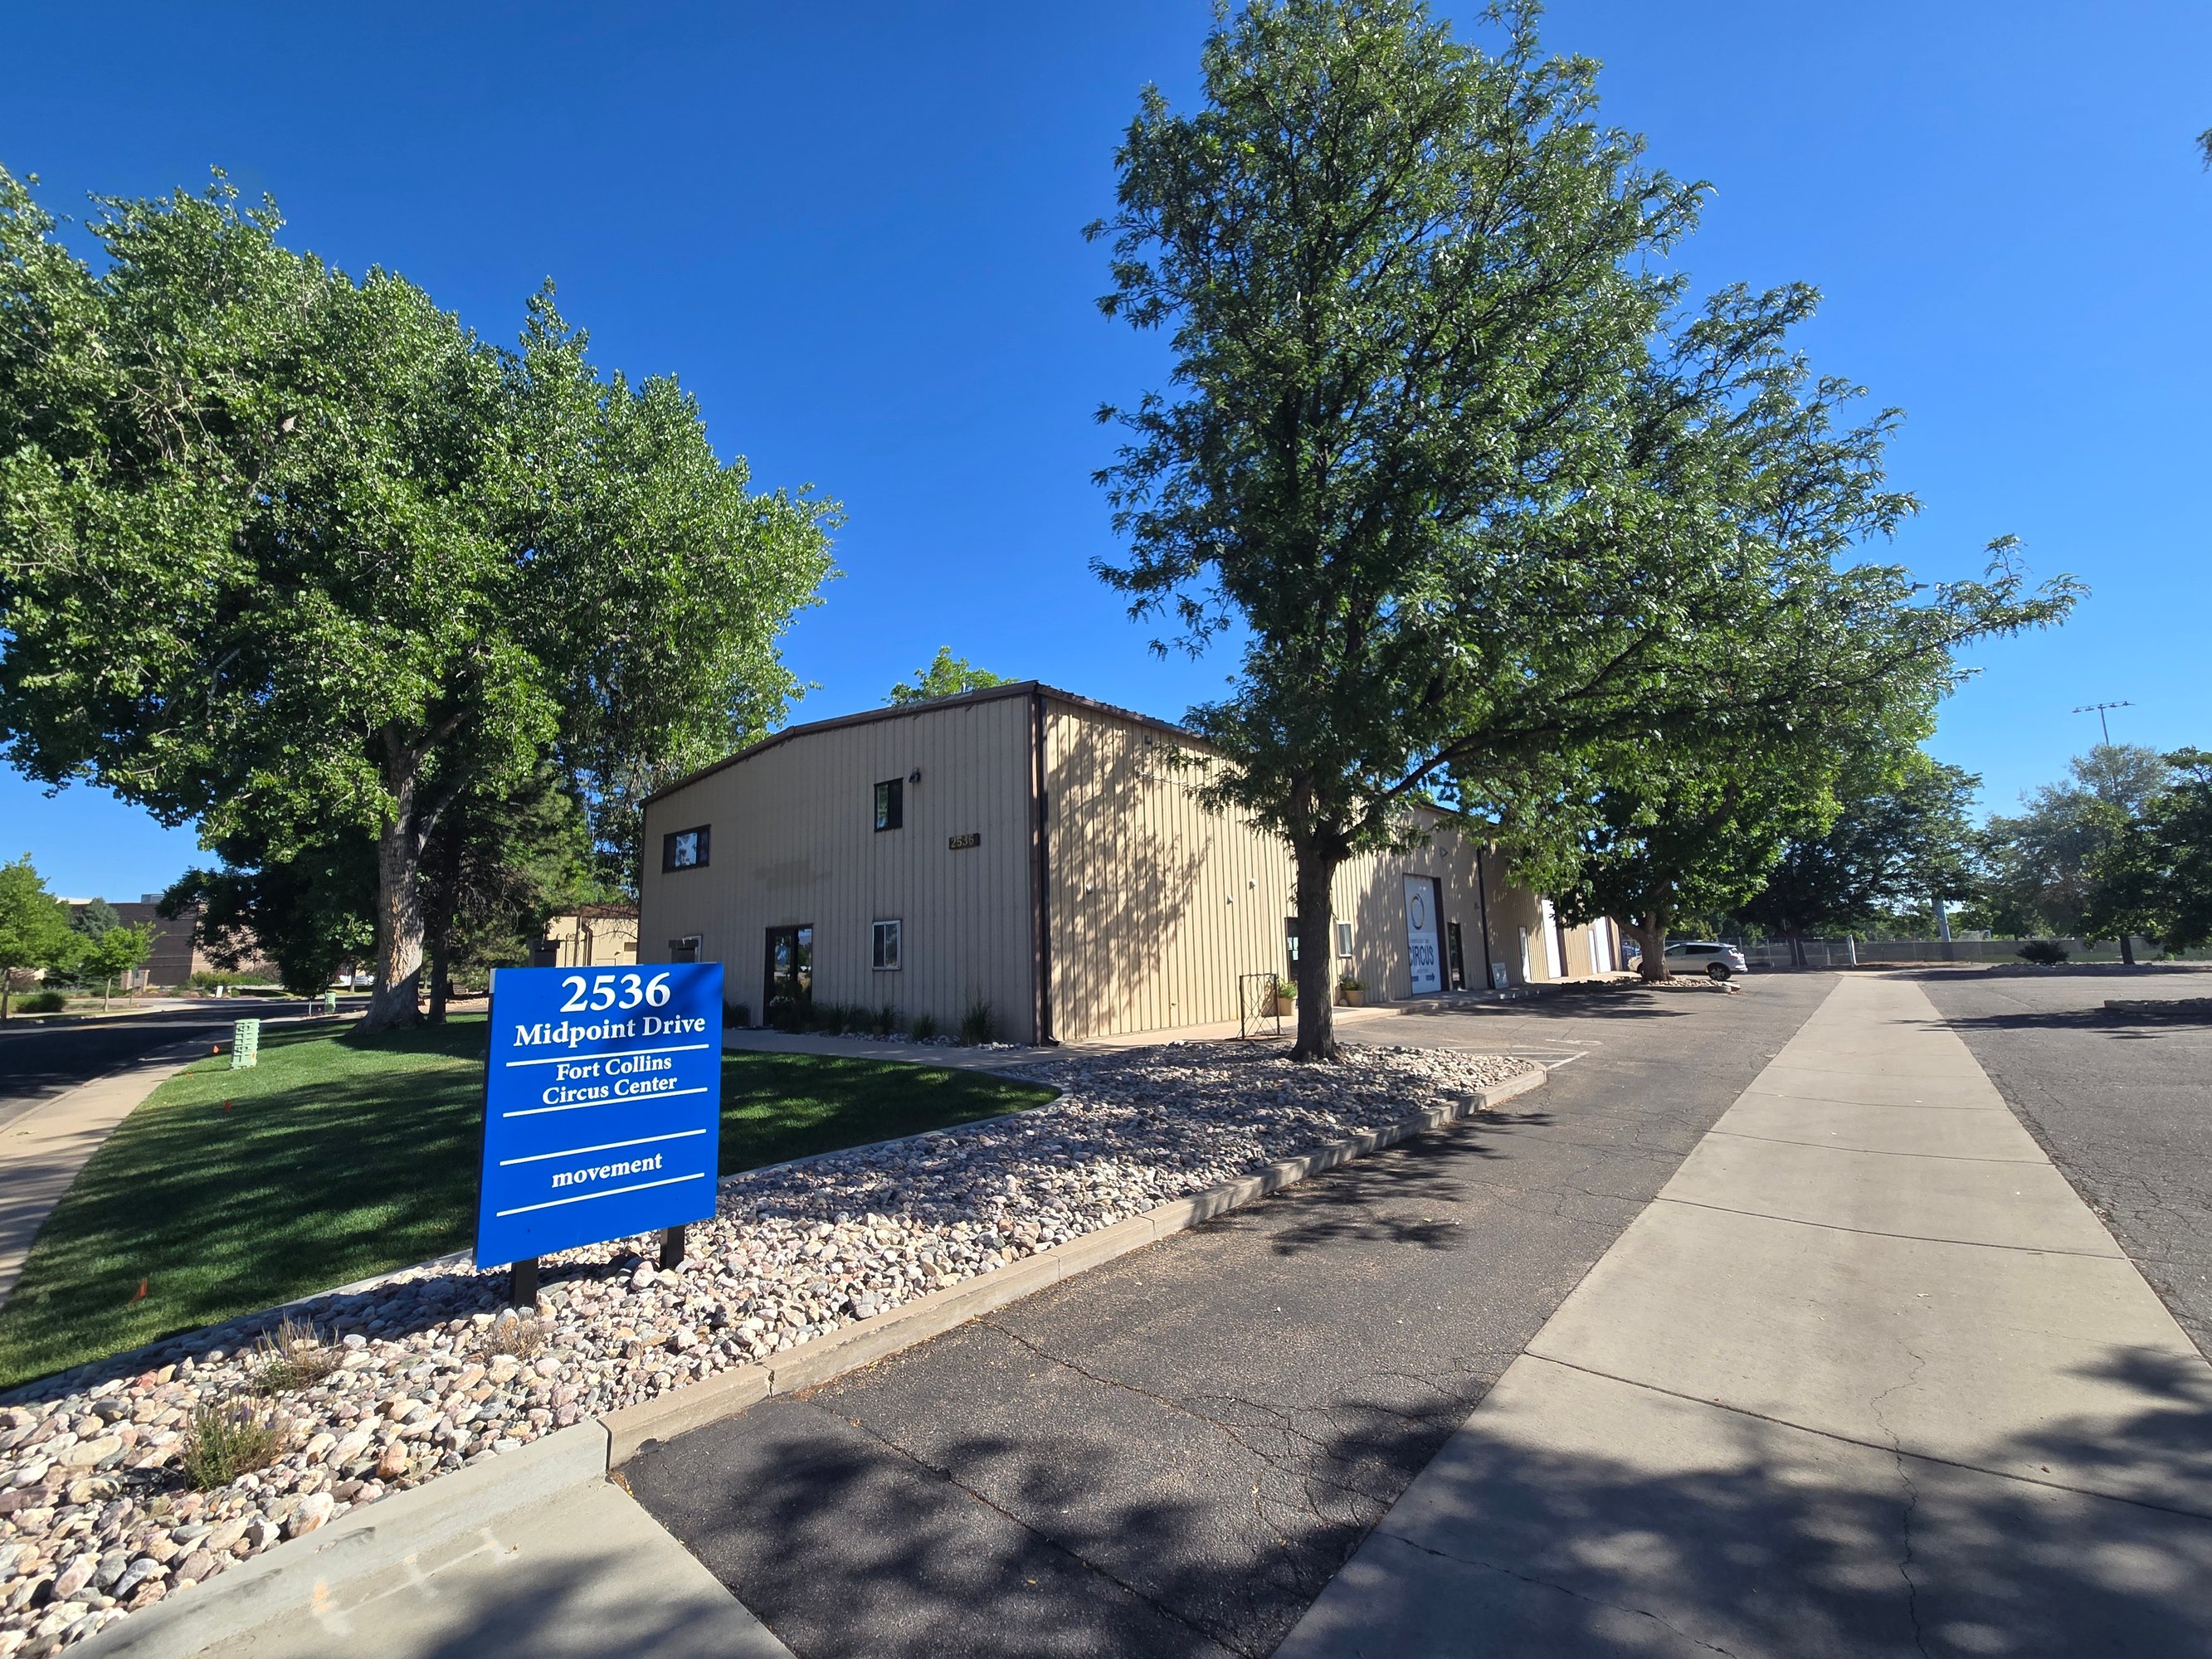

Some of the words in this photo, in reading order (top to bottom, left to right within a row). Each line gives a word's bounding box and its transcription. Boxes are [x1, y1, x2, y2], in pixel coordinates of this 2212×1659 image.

[950, 834, 975, 848] 2536
[559, 971, 671, 1013] 2536
[513, 1019, 636, 1048] Midpoint
[641, 1014, 706, 1036] Drive
[556, 1061, 601, 1081] Fort
[604, 1055, 672, 1076] Collins
[542, 1086, 609, 1105] Circus
[613, 1075, 678, 1097] Center
[551, 1153, 663, 1189] movement
